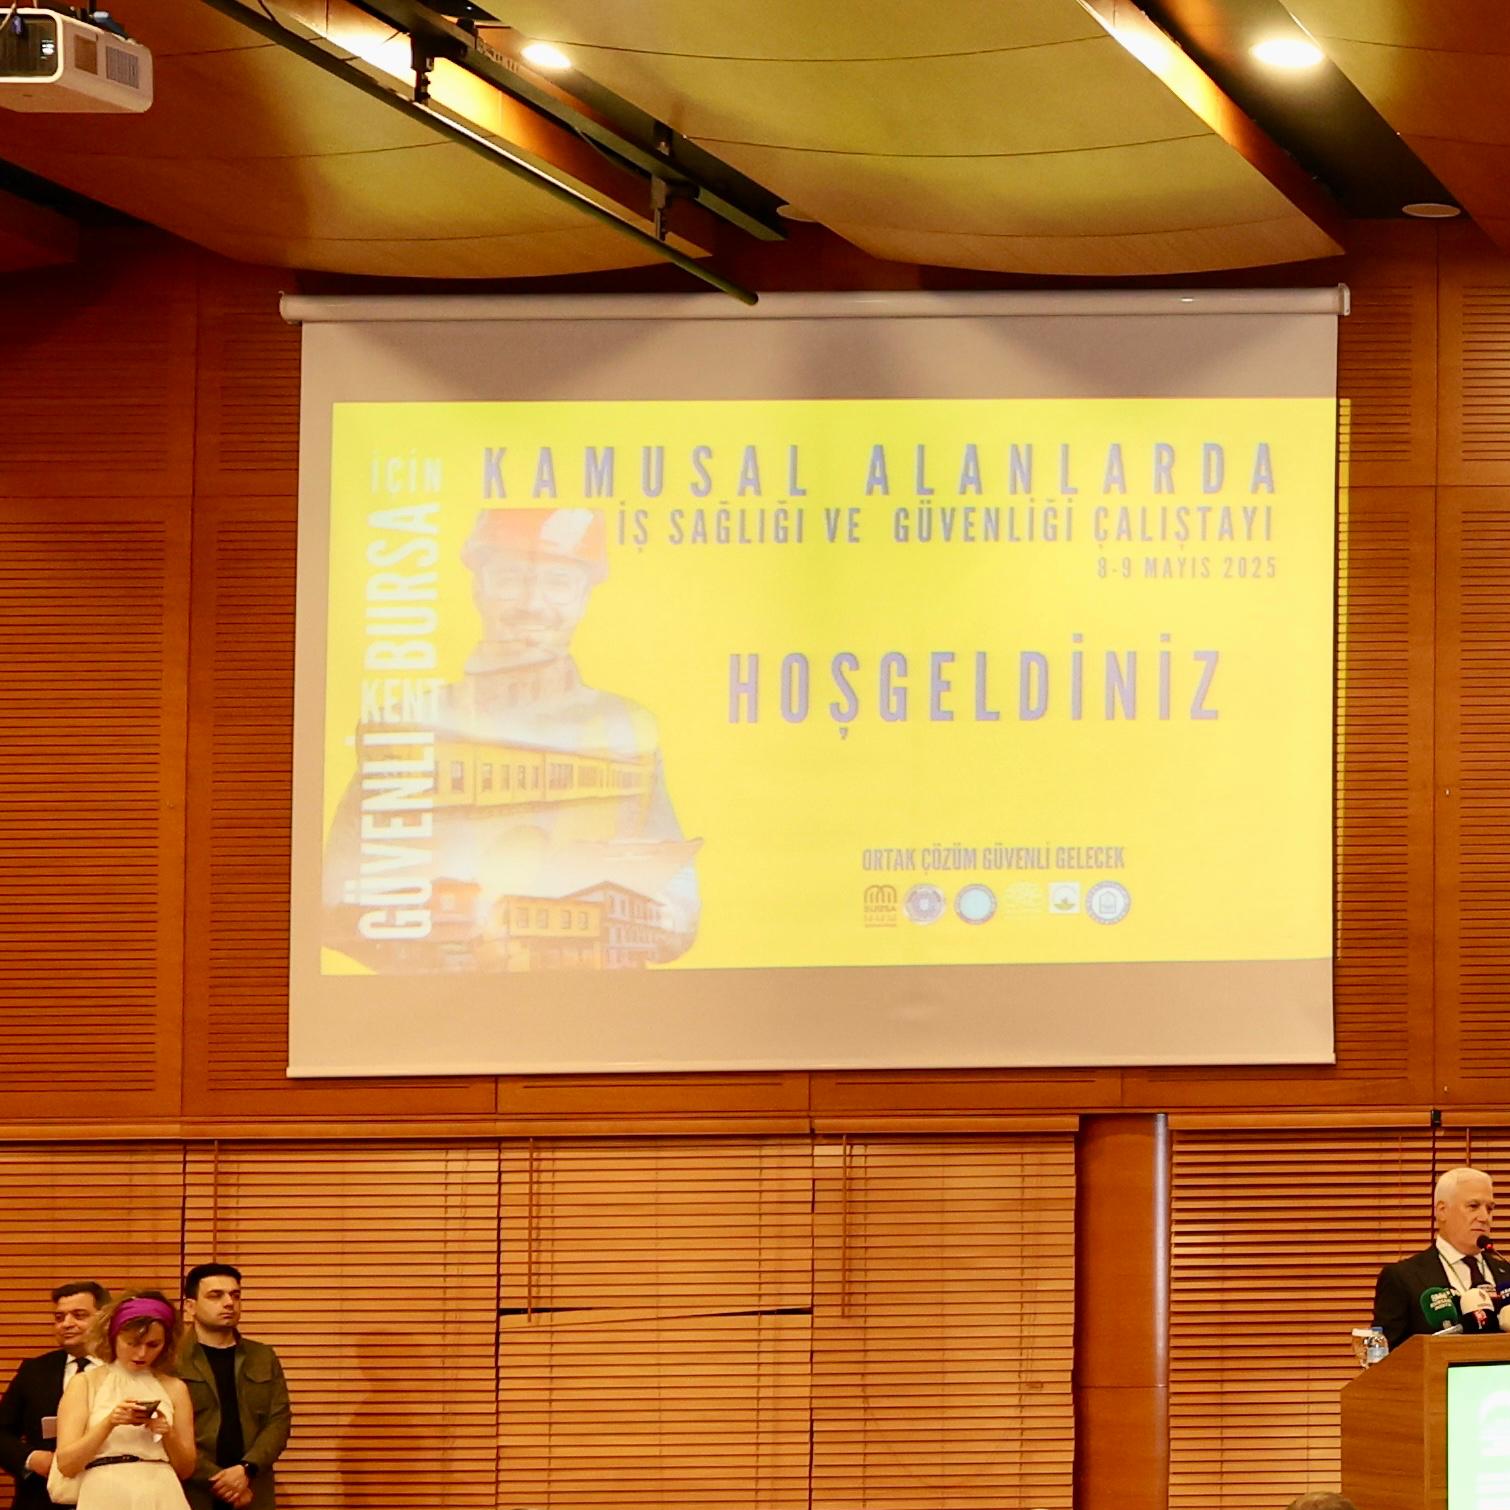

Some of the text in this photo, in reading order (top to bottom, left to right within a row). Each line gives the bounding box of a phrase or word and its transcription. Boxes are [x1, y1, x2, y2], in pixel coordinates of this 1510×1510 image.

[483, 443, 1275, 499] KAMUSAL ALANLARDA
[618, 497, 1272, 553] İŞ SAĞLIĞI VE GÜVENLİĞİ ÇALIŞTAYI
[363, 501, 441, 672] BURSA
[1097, 557, 1277, 578] 8-9 MAYIS 2025
[361, 678, 445, 724] KENT
[727, 632, 1220, 740] HOŞGELDİNİZ
[344, 730, 435, 940] GÜVENLİ
[862, 842, 1125, 876] ORTAK ÇÖZÜM GÜVENLİ GELECEK
